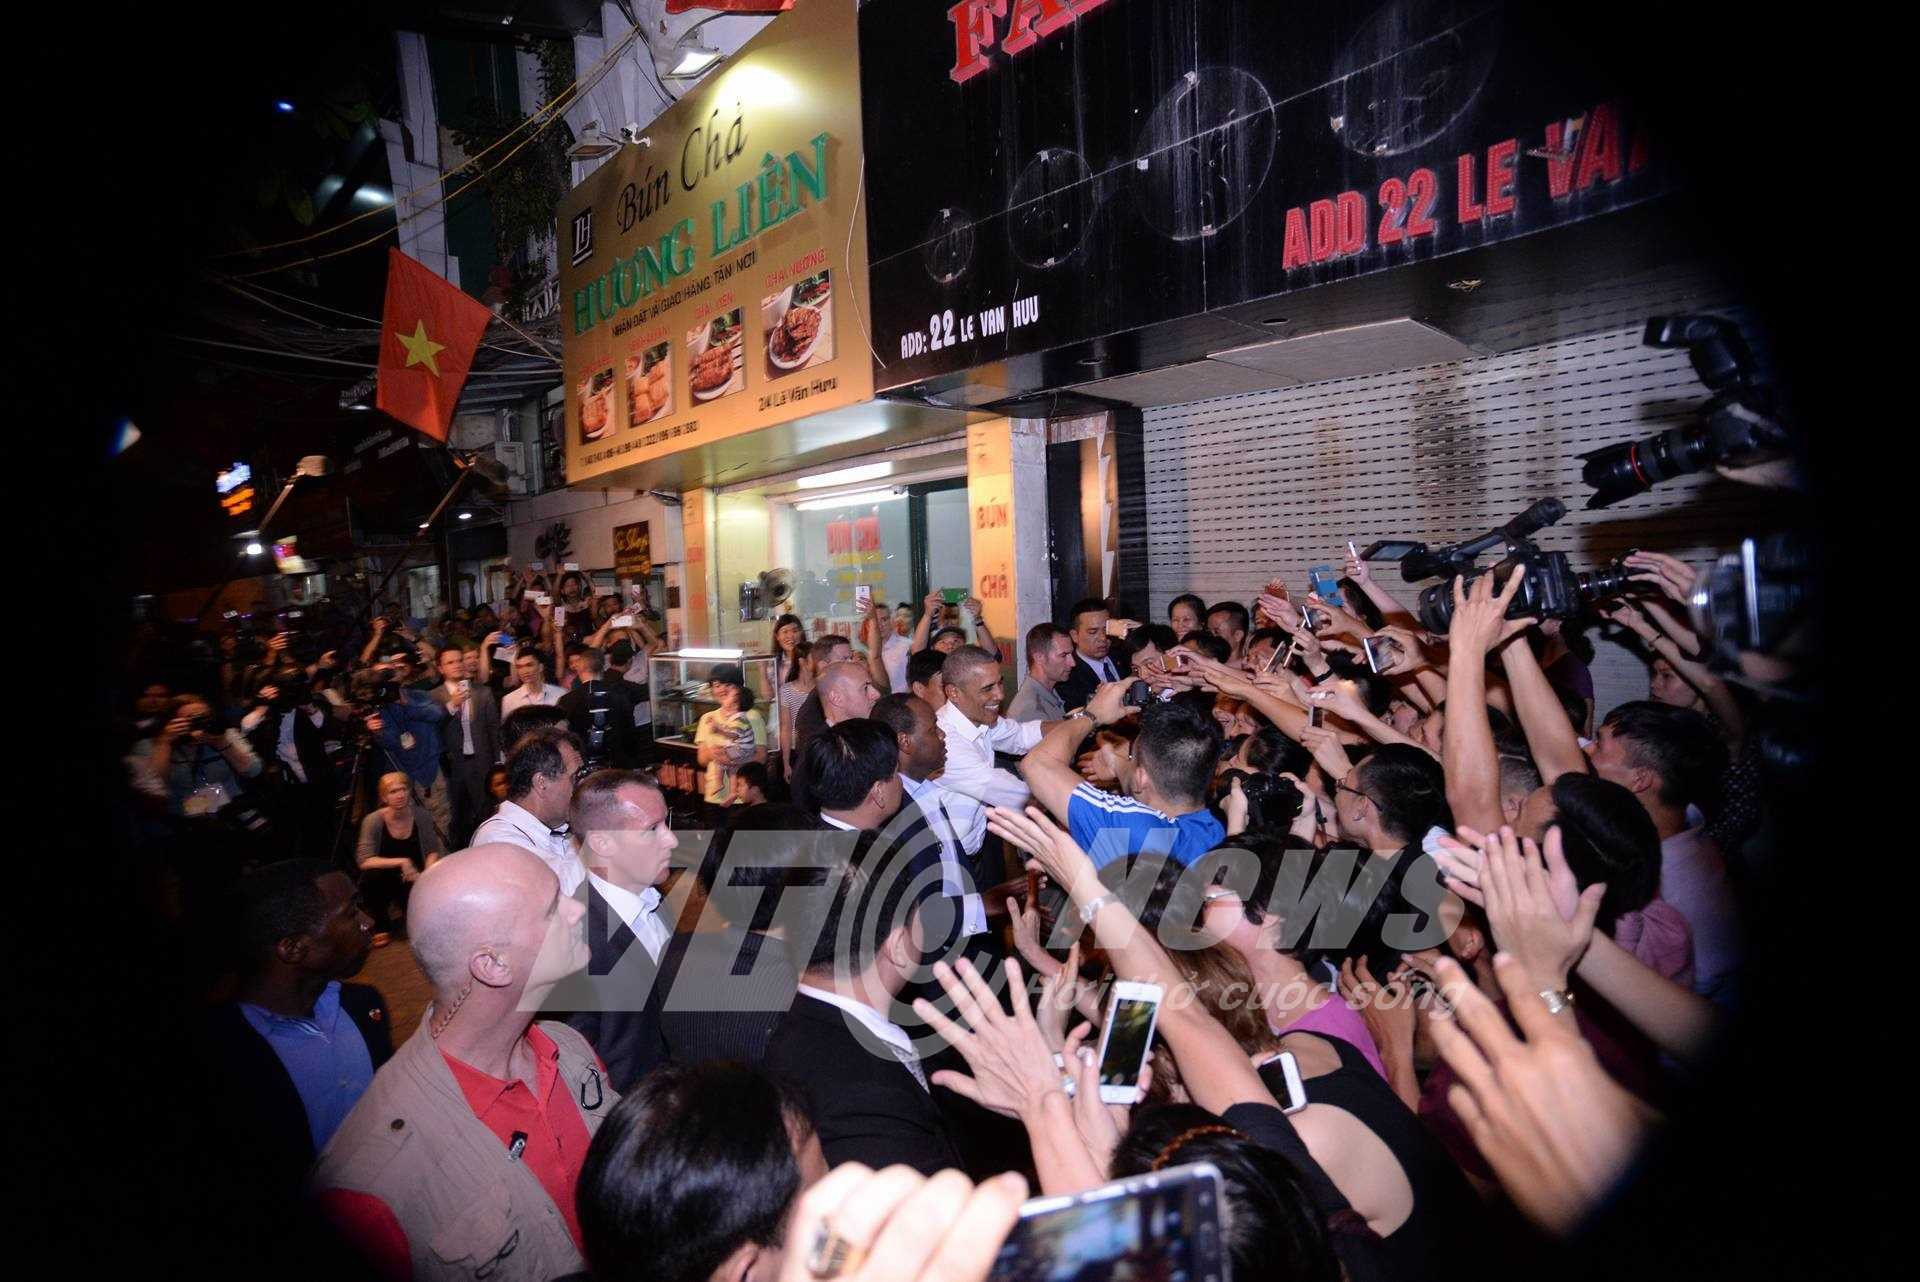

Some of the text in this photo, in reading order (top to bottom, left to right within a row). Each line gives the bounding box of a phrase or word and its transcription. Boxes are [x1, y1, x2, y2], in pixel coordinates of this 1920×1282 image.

[573, 130, 831, 336] HƯƠNG LIÊN
[617, 96, 749, 236] Bún Chả
[1281, 190, 1368, 272] ADD
[1377, 167, 1440, 246] 22
[1457, 138, 1519, 225] LE
[901, 295, 1039, 359] ADD: 22 LE VAN HUU
